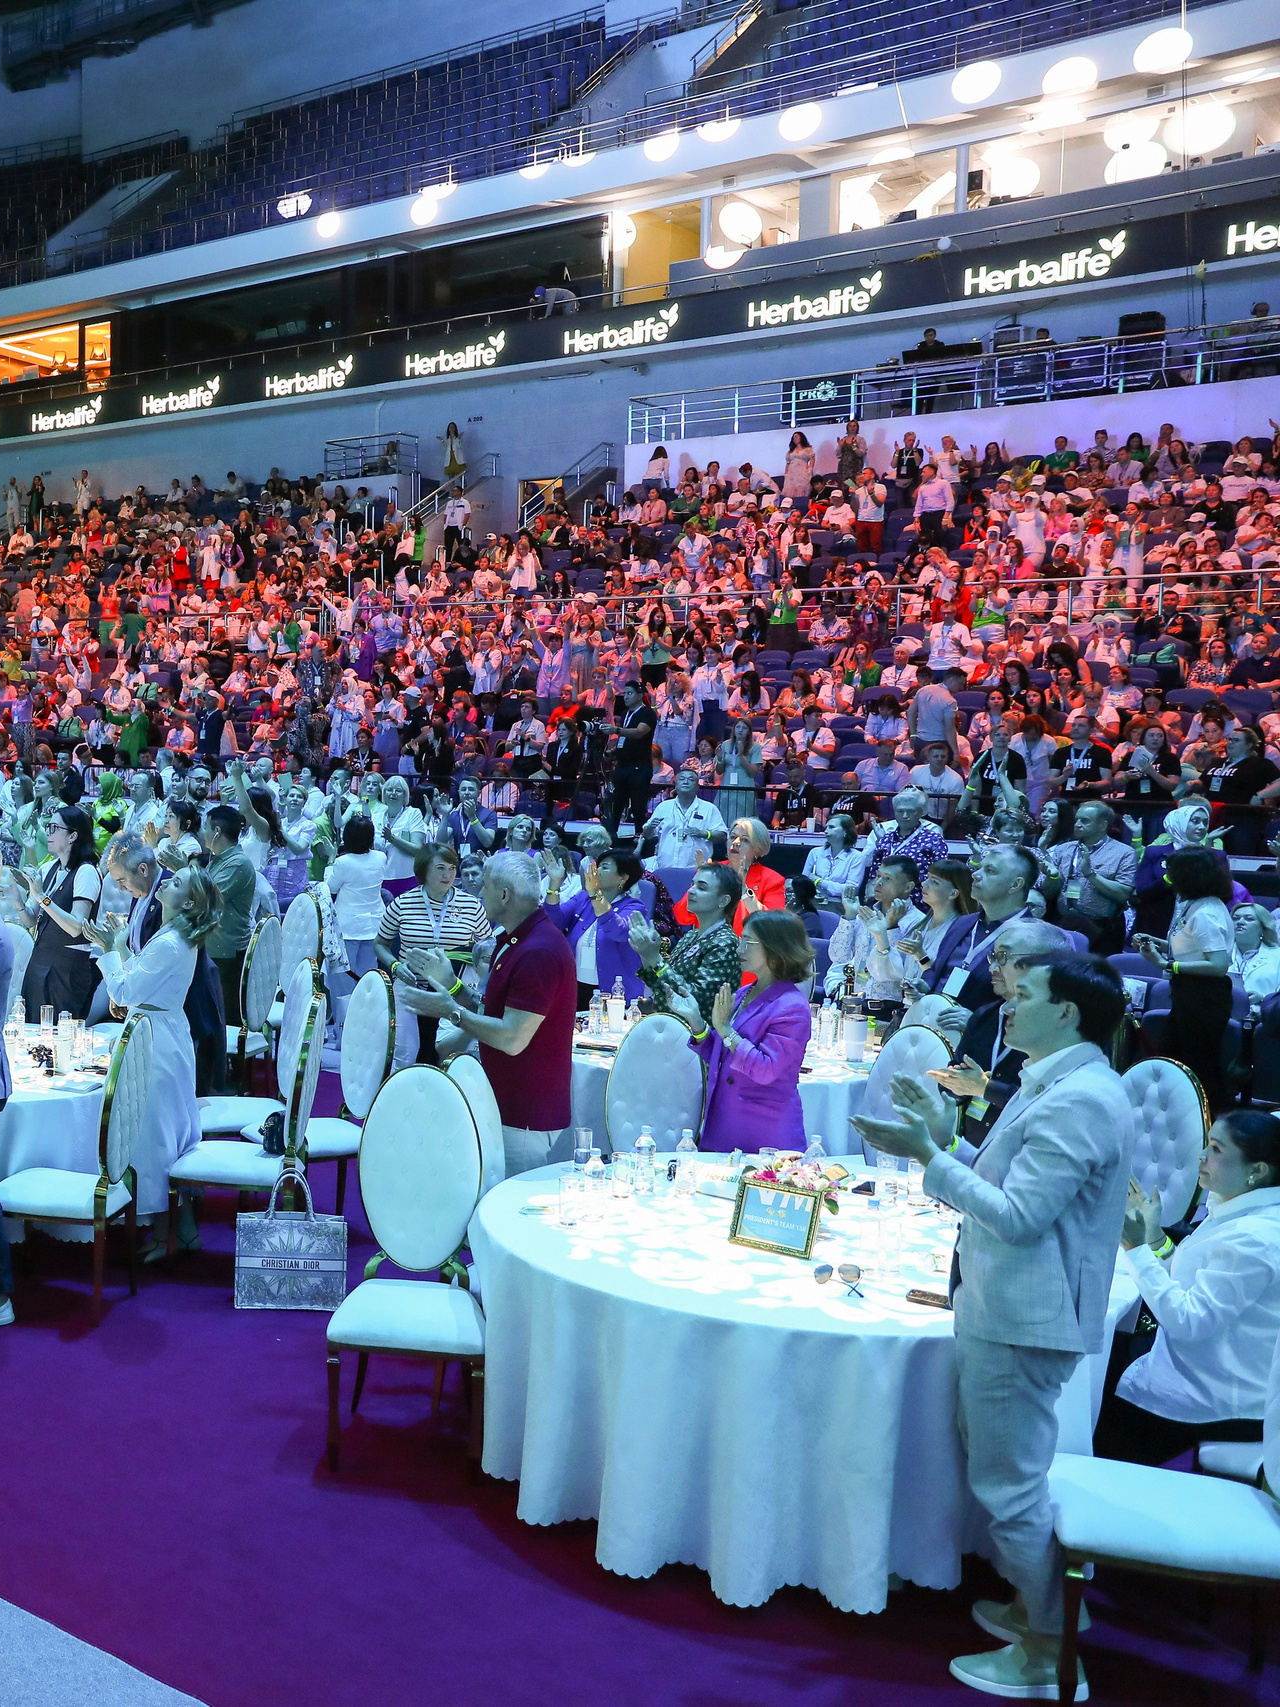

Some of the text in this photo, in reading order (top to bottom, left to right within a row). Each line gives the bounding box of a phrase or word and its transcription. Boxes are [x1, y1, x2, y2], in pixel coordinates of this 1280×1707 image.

[1226, 221, 1280, 255] He
[963, 247, 1111, 296] Herbalife
[747, 285, 871, 328] Herbalife
[563, 317, 669, 355] Herbalife
[405, 343, 497, 377] Herbalife
[265, 366, 346, 398] Herbalife
[142, 386, 213, 416] Herbalife
[32, 405, 96, 431] Herbalife
[705, 1173, 740, 1184] Herbali
[743, 1213, 779, 1227] PRESIDENT'S
[780, 1220, 795, 1230] TEAM
[261, 1258, 320, 1270] CHRISTIAN DIOR
